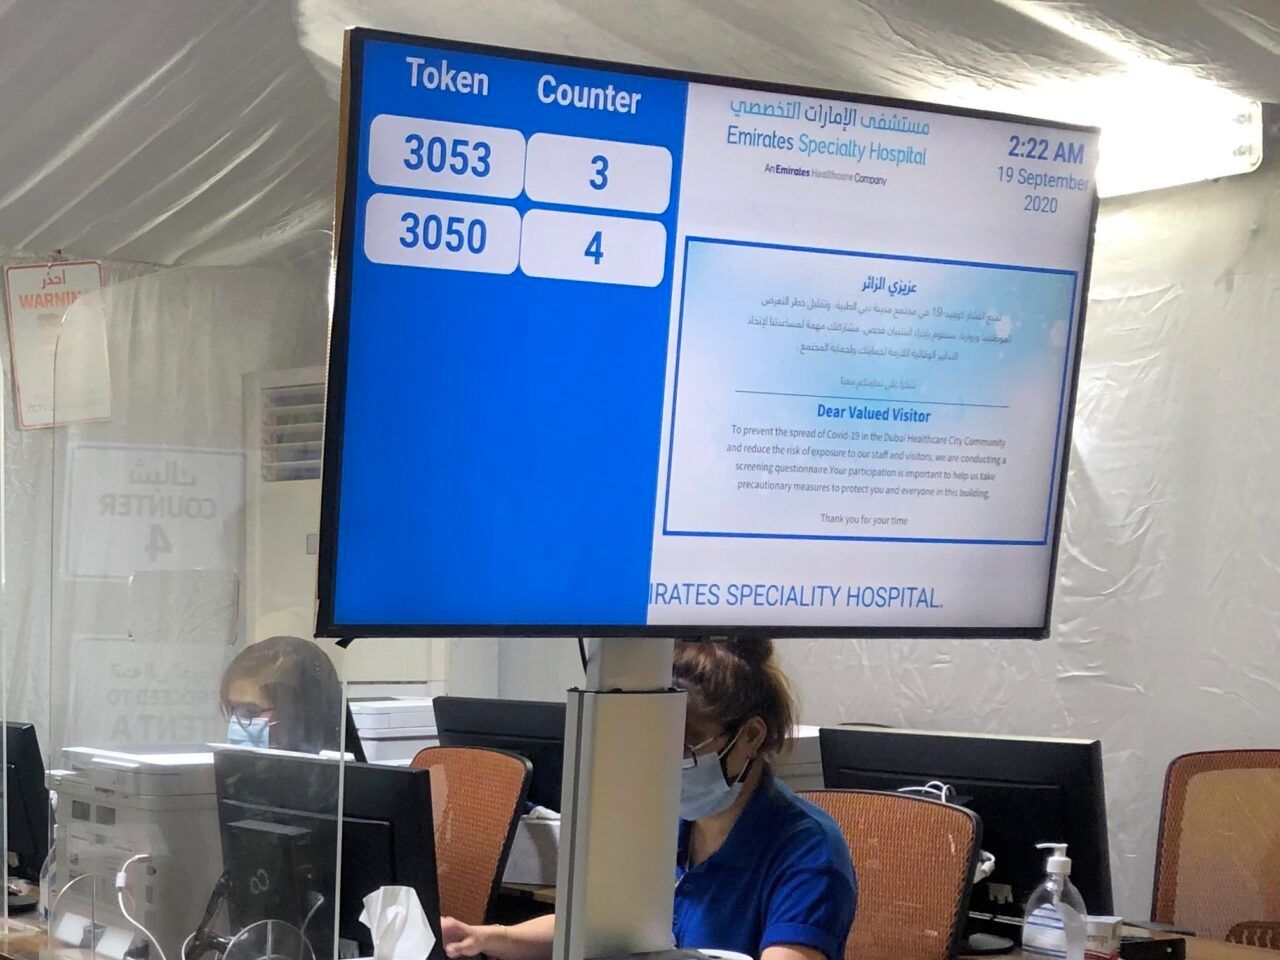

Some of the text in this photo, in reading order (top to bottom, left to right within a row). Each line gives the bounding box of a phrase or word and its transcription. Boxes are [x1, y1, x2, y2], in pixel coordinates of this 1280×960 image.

[406, 56, 642, 114] Token Counter
[804, 104, 857, 131] الإمارات
[860, 113, 930, 135] مستشفى
[727, 125, 927, 168] Emirates Specialty Hospital
[1008, 135, 1085, 165] 2:22 AM
[403, 133, 609, 190] 3053 3
[764, 163, 775, 174] An
[775, 164, 810, 177] Emirates
[854, 172, 888, 186] Company
[998, 165, 1088, 192] 19 September
[1024, 194, 1058, 213] 2020
[399, 211, 604, 265] 3050 4
[861, 275, 917, 297] عزيزي الزائر
[817, 403, 931, 423] Dear Valued Visitor
[731, 424, 1006, 449] To prevent the spread of Covid-19 in the Dubai Healthcare City Community
[726, 443, 742, 453] and
[743, 443, 771, 454] reduce
[772, 444, 786, 455] the
[786, 445, 800, 455] risk
[801, 446, 811, 456] of
[811, 447, 846, 458] exposure
[847, 449, 856, 458] to
[857, 450, 870, 459] our
[871, 450, 889, 460] staff
[889, 451, 905, 460] and
[935, 454, 947, 462] we
[947, 455, 959, 463] are
[960, 454, 1001, 467] conducting
[735, 462, 773, 475] screening
[848, 467, 896, 478] participation
[897, 469, 904, 477] is
[905, 470, 942, 480] important
[943, 471, 951, 479] to
[953, 472, 969, 482] help
[970, 473, 979, 481] us
[980, 473, 996, 481] take
[737, 480, 792, 493] precautionary
[793, 482, 830, 492] measures
[831, 483, 840, 493] to
[841, 484, 869, 494] protect
[870, 486, 884, 496] you
[885, 486, 900, 495] and
[901, 488, 934, 498] everyone
[936, 487, 944, 496] in
[944, 487, 958, 497] this
[821, 513, 908, 526] Thank you for your time
[649, 582, 944, 609] IRATES SPECIALITY HOSPITAL.
